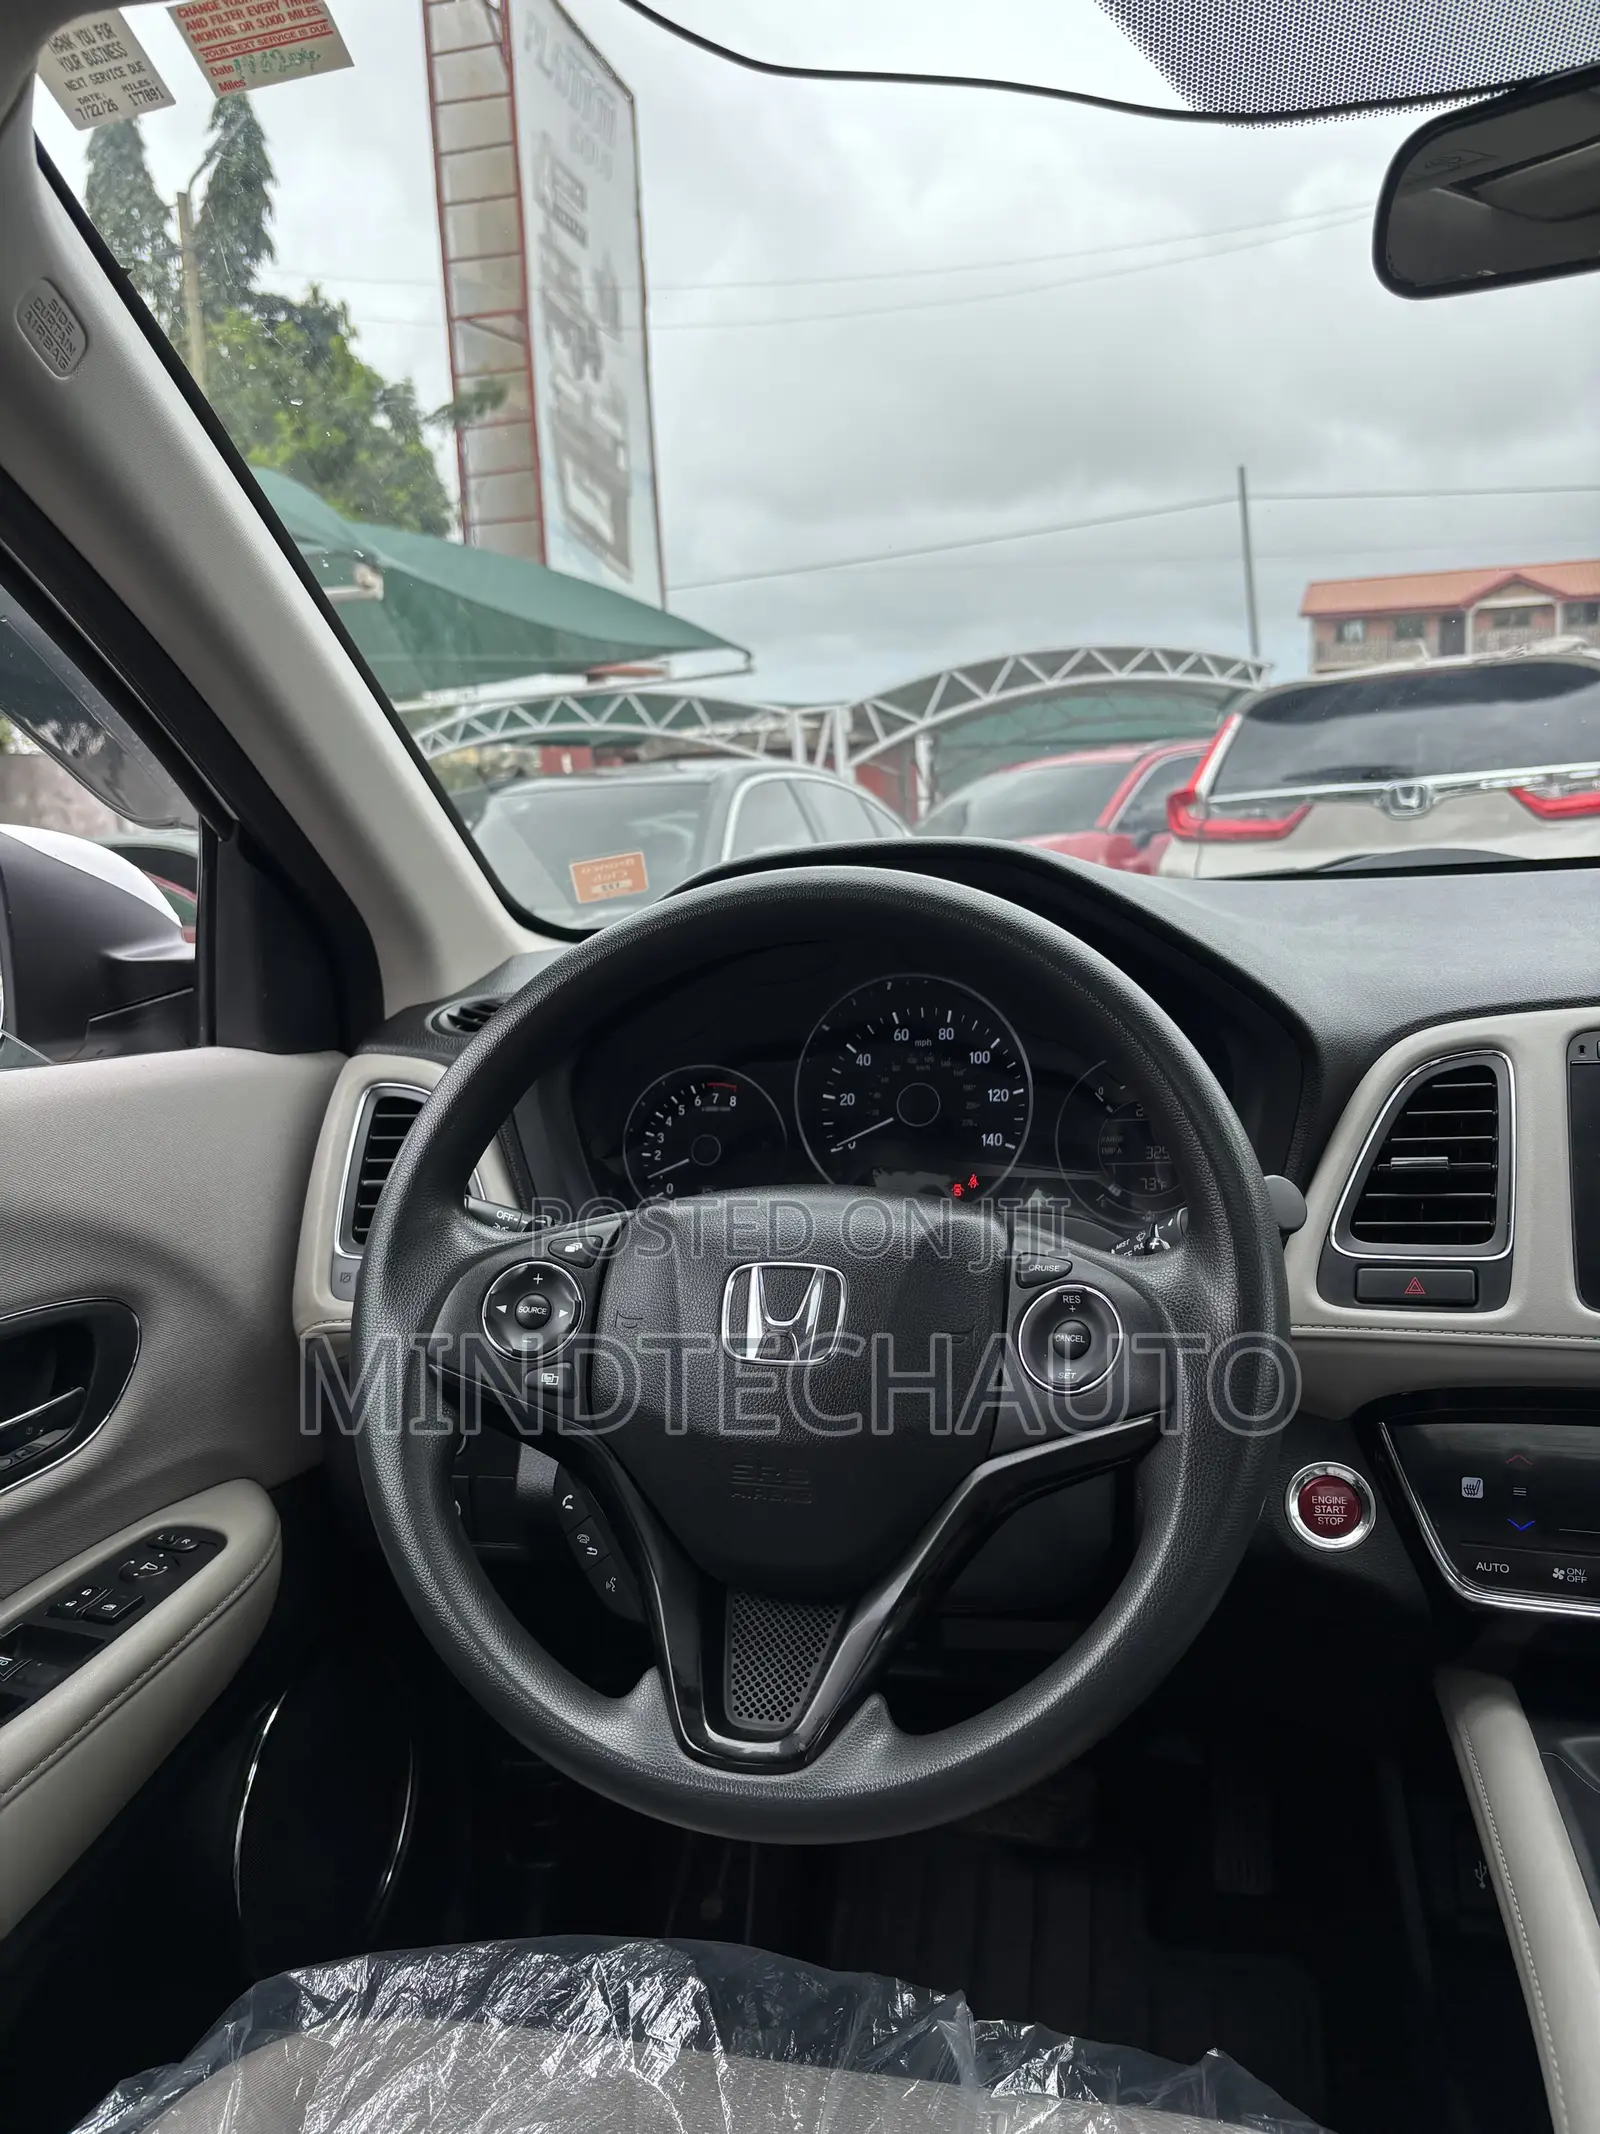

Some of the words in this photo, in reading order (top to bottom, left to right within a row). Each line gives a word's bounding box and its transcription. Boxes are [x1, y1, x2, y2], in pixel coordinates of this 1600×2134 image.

[176, 0, 221, 18] CHANGE
[186, 18, 208, 31] AND
[211, 10, 246, 26] FILTER
[247, 2, 281, 17] EVERY
[73, 27, 97, 47] YOU
[92, 22, 118, 41] FOR
[190, 25, 237, 44] MONTHS
[239, 22, 255, 34] OR
[257, 15, 286, 29] 3,000
[202, 46, 229, 59] YOUR
[231, 42, 256, 54] NEXT
[257, 31, 296, 48] SERVICE
[298, 28, 309, 37] IS
[310, 23, 330, 35] DUE
[55, 53, 86, 73] YOUR
[81, 41, 128, 67] BUSINESS
[64, 77, 89, 92] NEXT
[88, 66, 127, 85] SERVICE
[126, 61, 147, 75] DUE
[209, 65, 235, 77] Date
[217, 79, 247, 92] Miles
[128, 86, 165, 107] 177891
[48, 298, 76, 336] SIDE
[33, 296, 76, 357] CURTAIN
[24, 310, 69, 371] AIRBAG
[893, 1028, 910, 1041] 60
[937, 1027, 955, 1041] 80
[914, 1038, 932, 1047] mph
[855, 1053, 872, 1066] 40
[968, 1051, 991, 1064] 100
[693, 1095, 702, 1107] 6
[712, 1092, 719, 1104] 7
[729, 1095, 737, 1107] 8
[839, 1092, 856, 1106] 20
[987, 1088, 1010, 1102] 120
[677, 1104, 686, 1115] 5
[665, 1116, 672, 1127] 4
[656, 1132, 665, 1144] 3
[981, 1132, 1003, 1147] 140
[654, 1150, 662, 1161] 2
[666, 1182, 674, 1194] 0
[496, 1210, 515, 1222] OFF
[1115, 1238, 1130, 1250] MIST
[1028, 1264, 1061, 1272] CRUISE
[1062, 1295, 1081, 1304] RES
[518, 1304, 548, 1316] SOURCE
[1055, 1333, 1086, 1344] CANCEL
[1057, 1371, 1077, 1380] SET
[1311, 1495, 1348, 1505] ENGINE
[1314, 1505, 1346, 1514] START
[1317, 1516, 1344, 1526] STOP
[1475, 1561, 1510, 1574] AUTO
[1566, 1567, 1586, 1576] ON/
[1566, 1575, 1588, 1584] OFF
